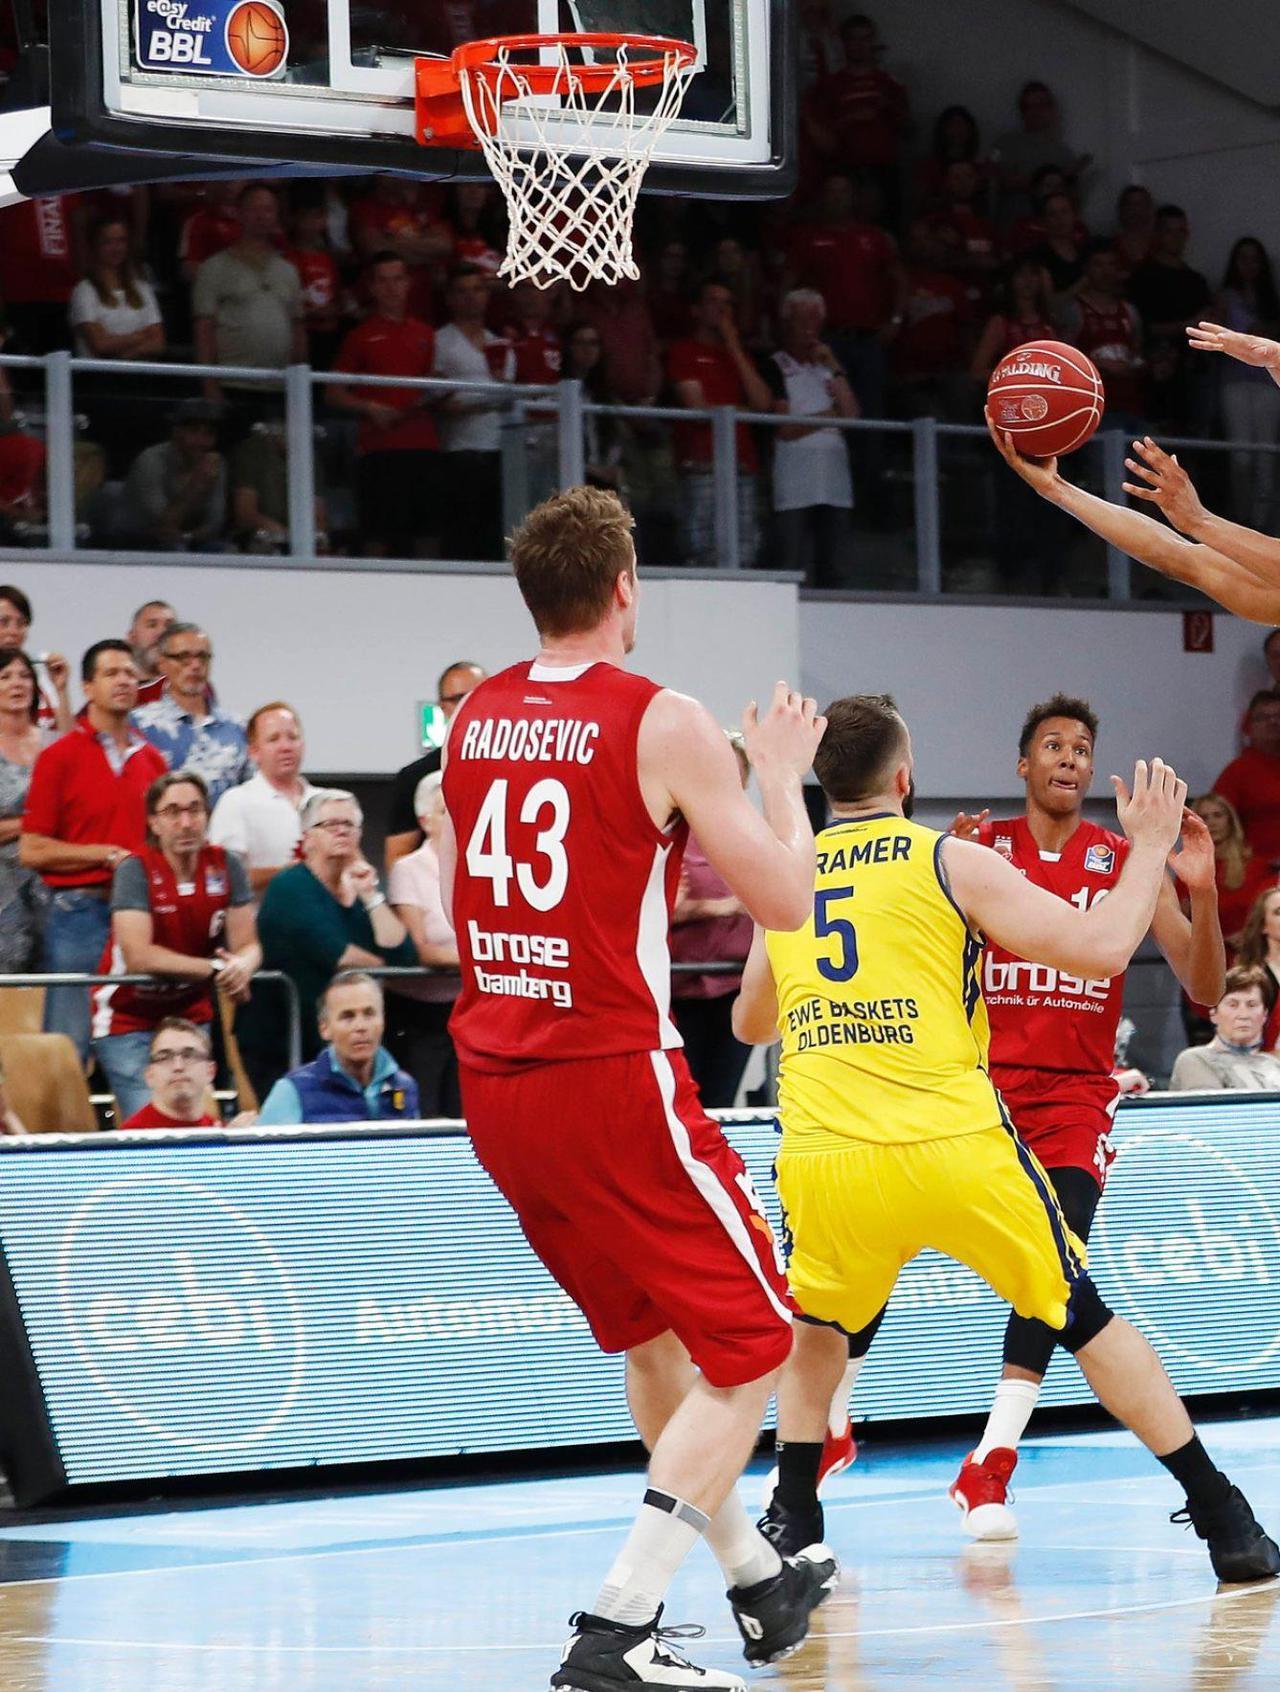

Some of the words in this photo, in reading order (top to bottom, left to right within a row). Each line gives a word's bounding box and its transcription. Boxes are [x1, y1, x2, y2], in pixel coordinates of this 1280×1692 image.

[148, 30, 212, 65] BBL
[460, 718, 600, 765] RADOSEVIC
[465, 778, 571, 913] 43
[815, 836, 911, 875] RAMER
[467, 920, 569, 968] brose
[814, 885, 860, 983] 5
[473, 965, 573, 1008] bamberg
[1043, 996, 1105, 1014] Automobile
[787, 999, 823, 1032] EWE
[830, 998, 919, 1020] BASKETS
[798, 1023, 914, 1052] OLDENBURG
[1122, 1195, 1270, 1286] cebi
[86, 1248, 277, 1352] cebi
